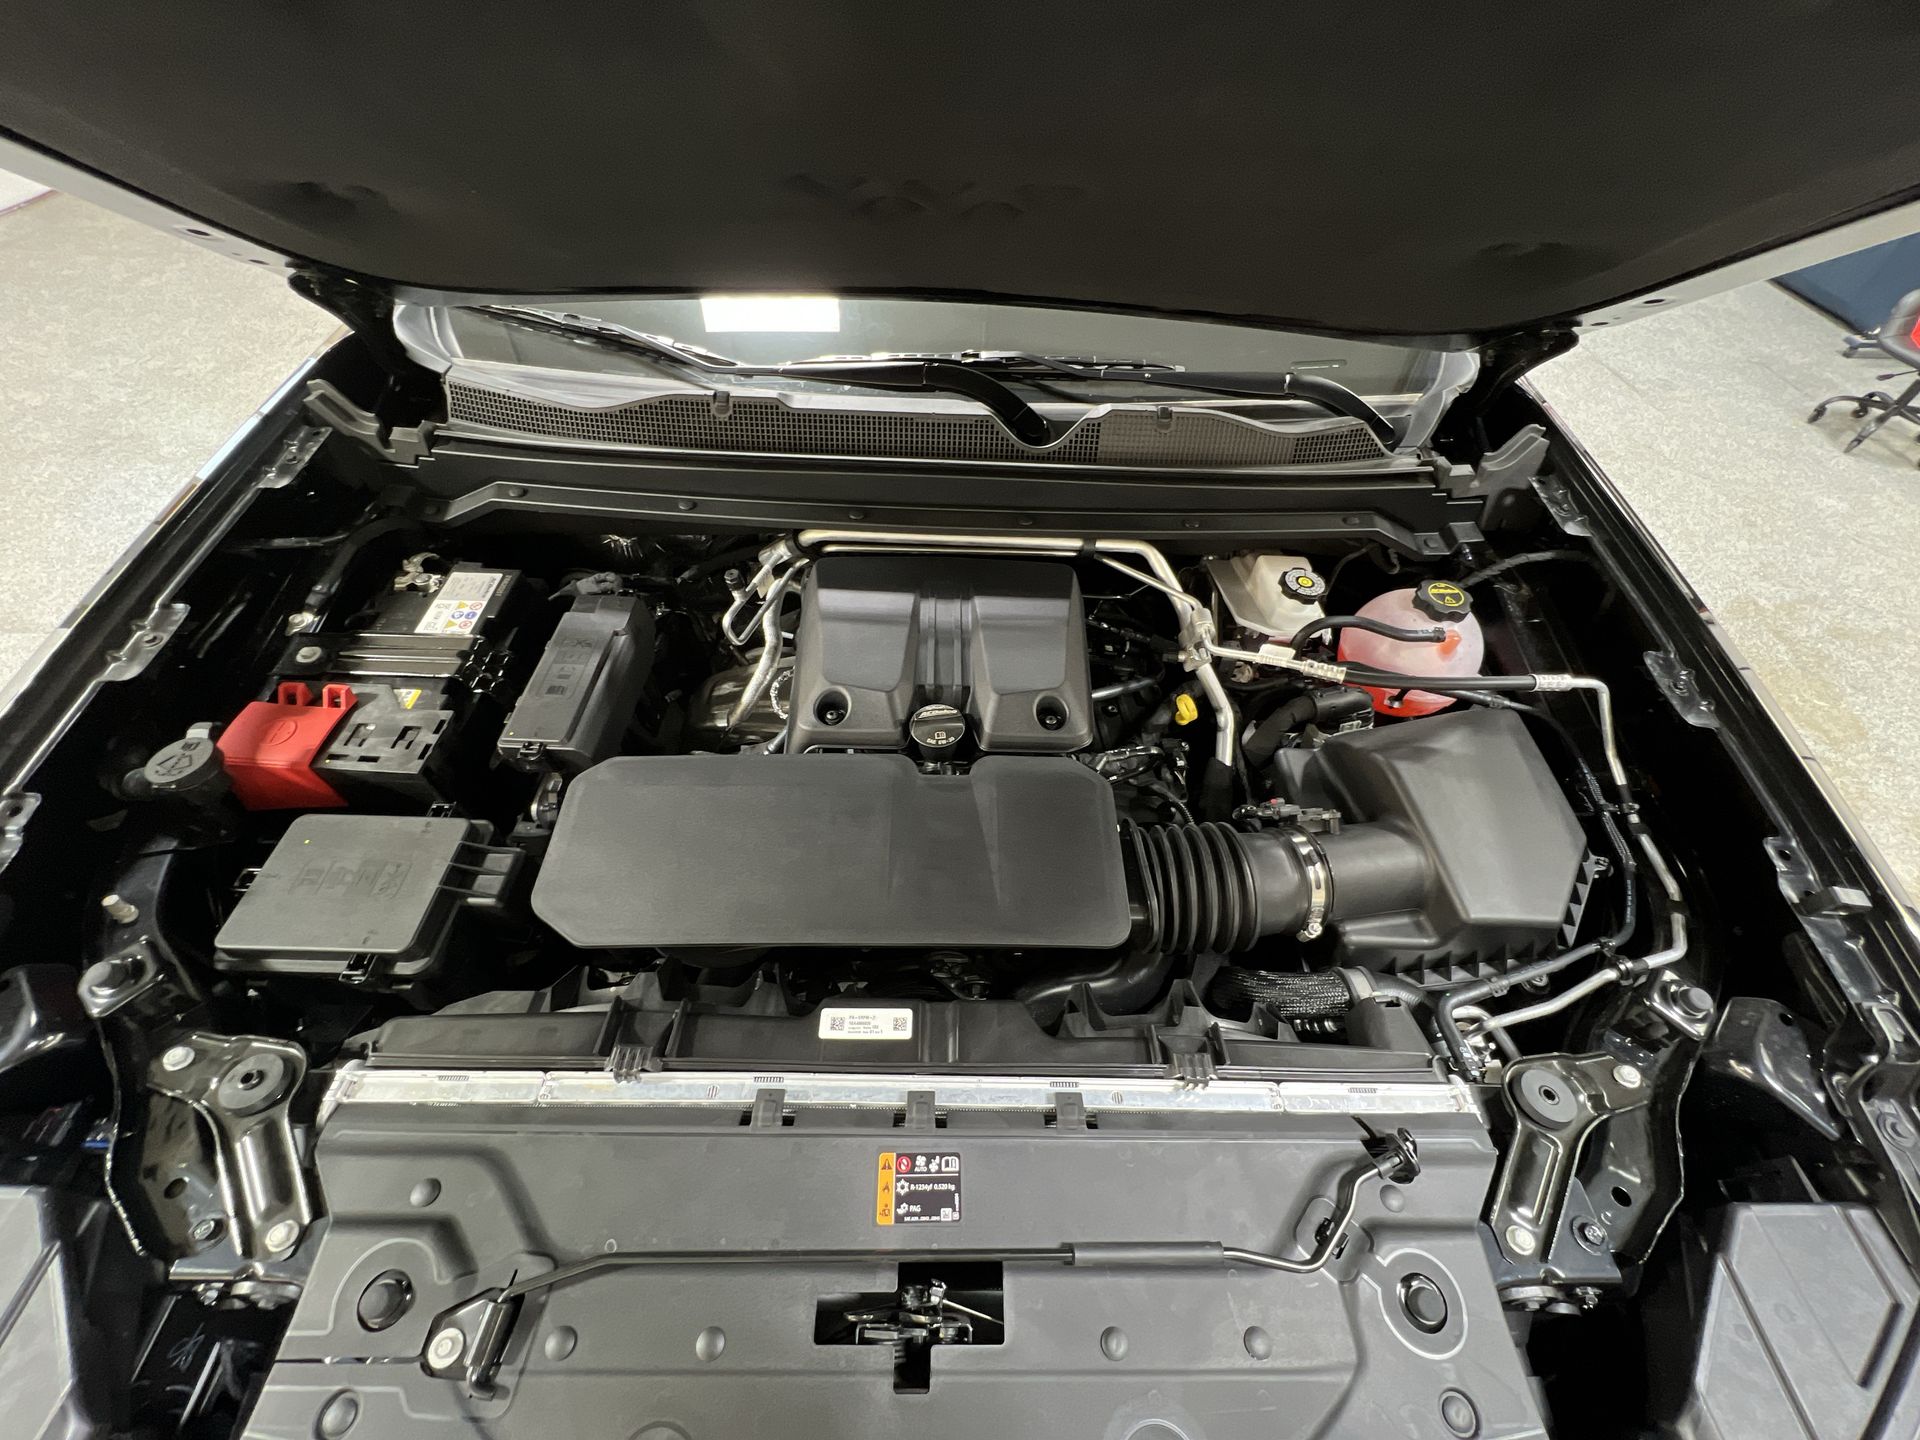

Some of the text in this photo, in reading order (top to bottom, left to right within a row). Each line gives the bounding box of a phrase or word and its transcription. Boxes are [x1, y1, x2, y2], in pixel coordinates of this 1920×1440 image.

[910, 1183, 933, 1191] R-1234yf
[948, 1183, 955, 1191] kg
[909, 1204, 921, 1212] PAG
